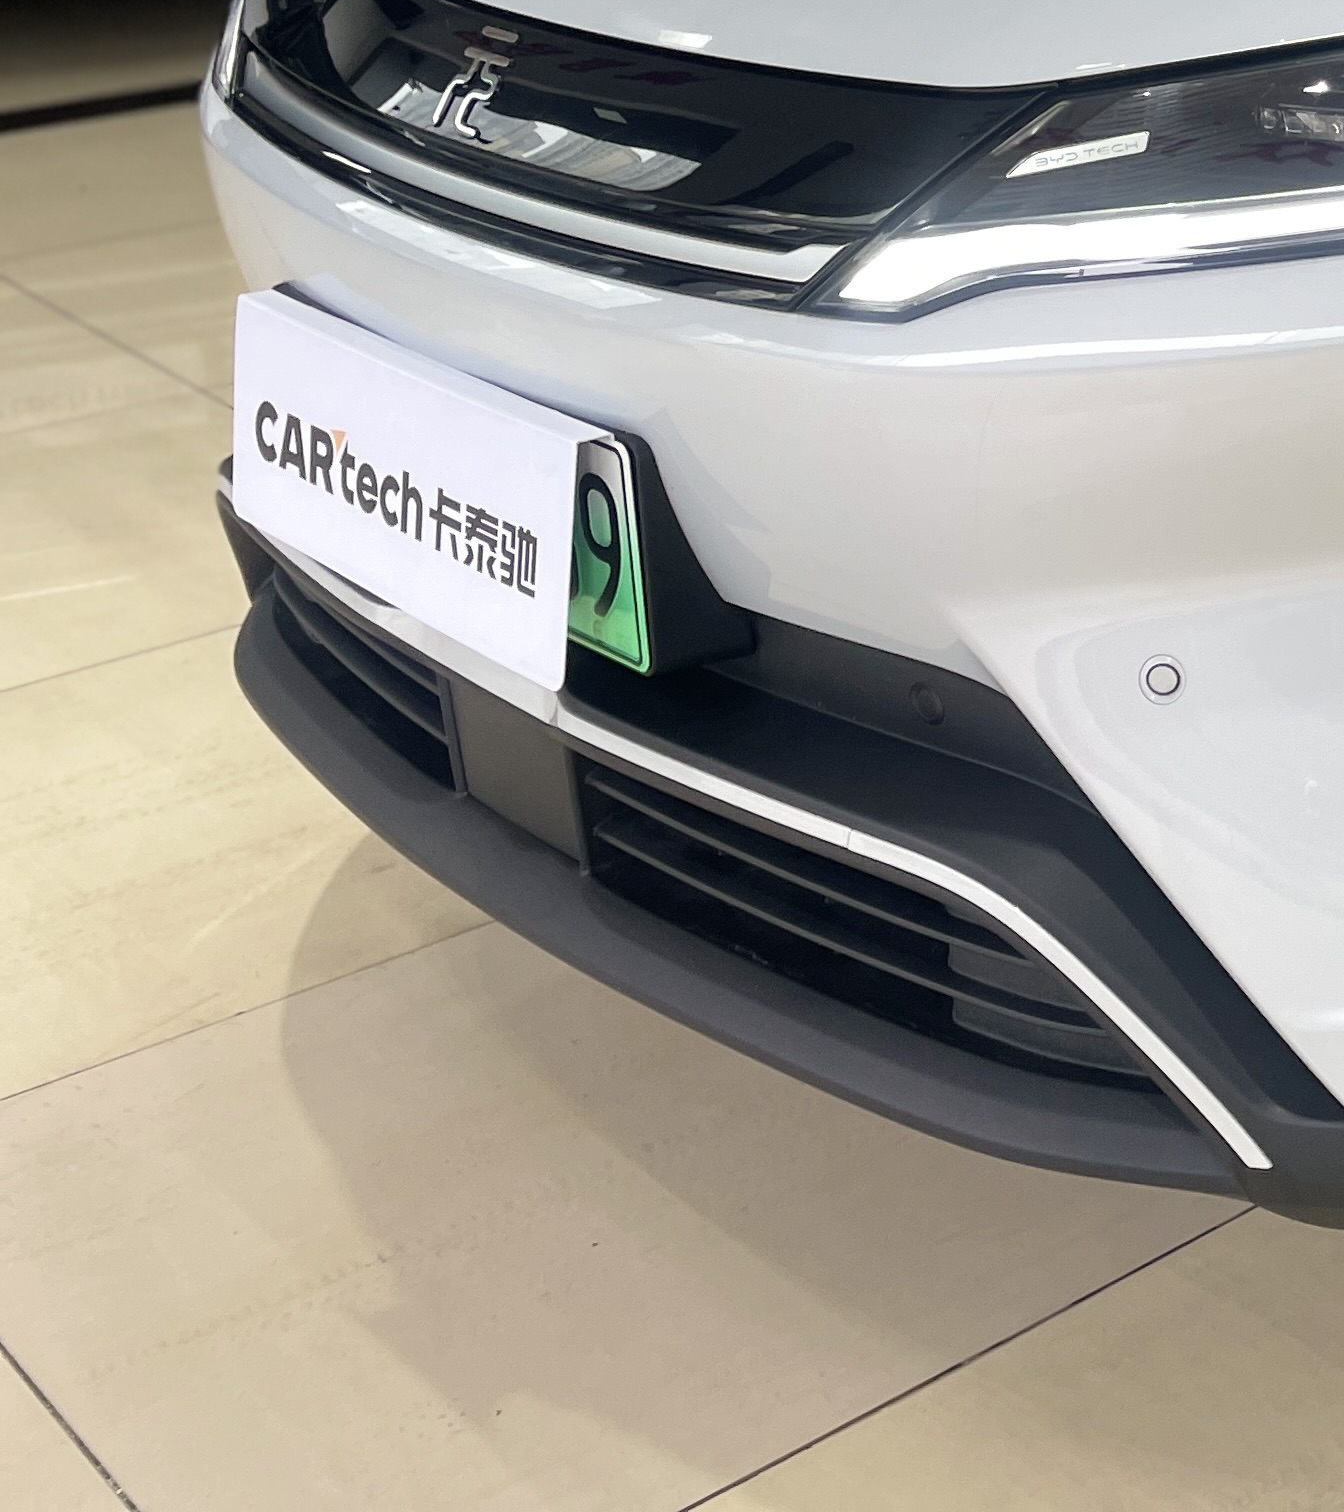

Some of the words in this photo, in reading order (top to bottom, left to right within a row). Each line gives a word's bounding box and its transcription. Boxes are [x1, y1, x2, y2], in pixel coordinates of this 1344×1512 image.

[1034, 151, 1078, 168] BYD
[1084, 141, 1138, 159] TECH
[429, 487, 538, 599] 卡泰驰
